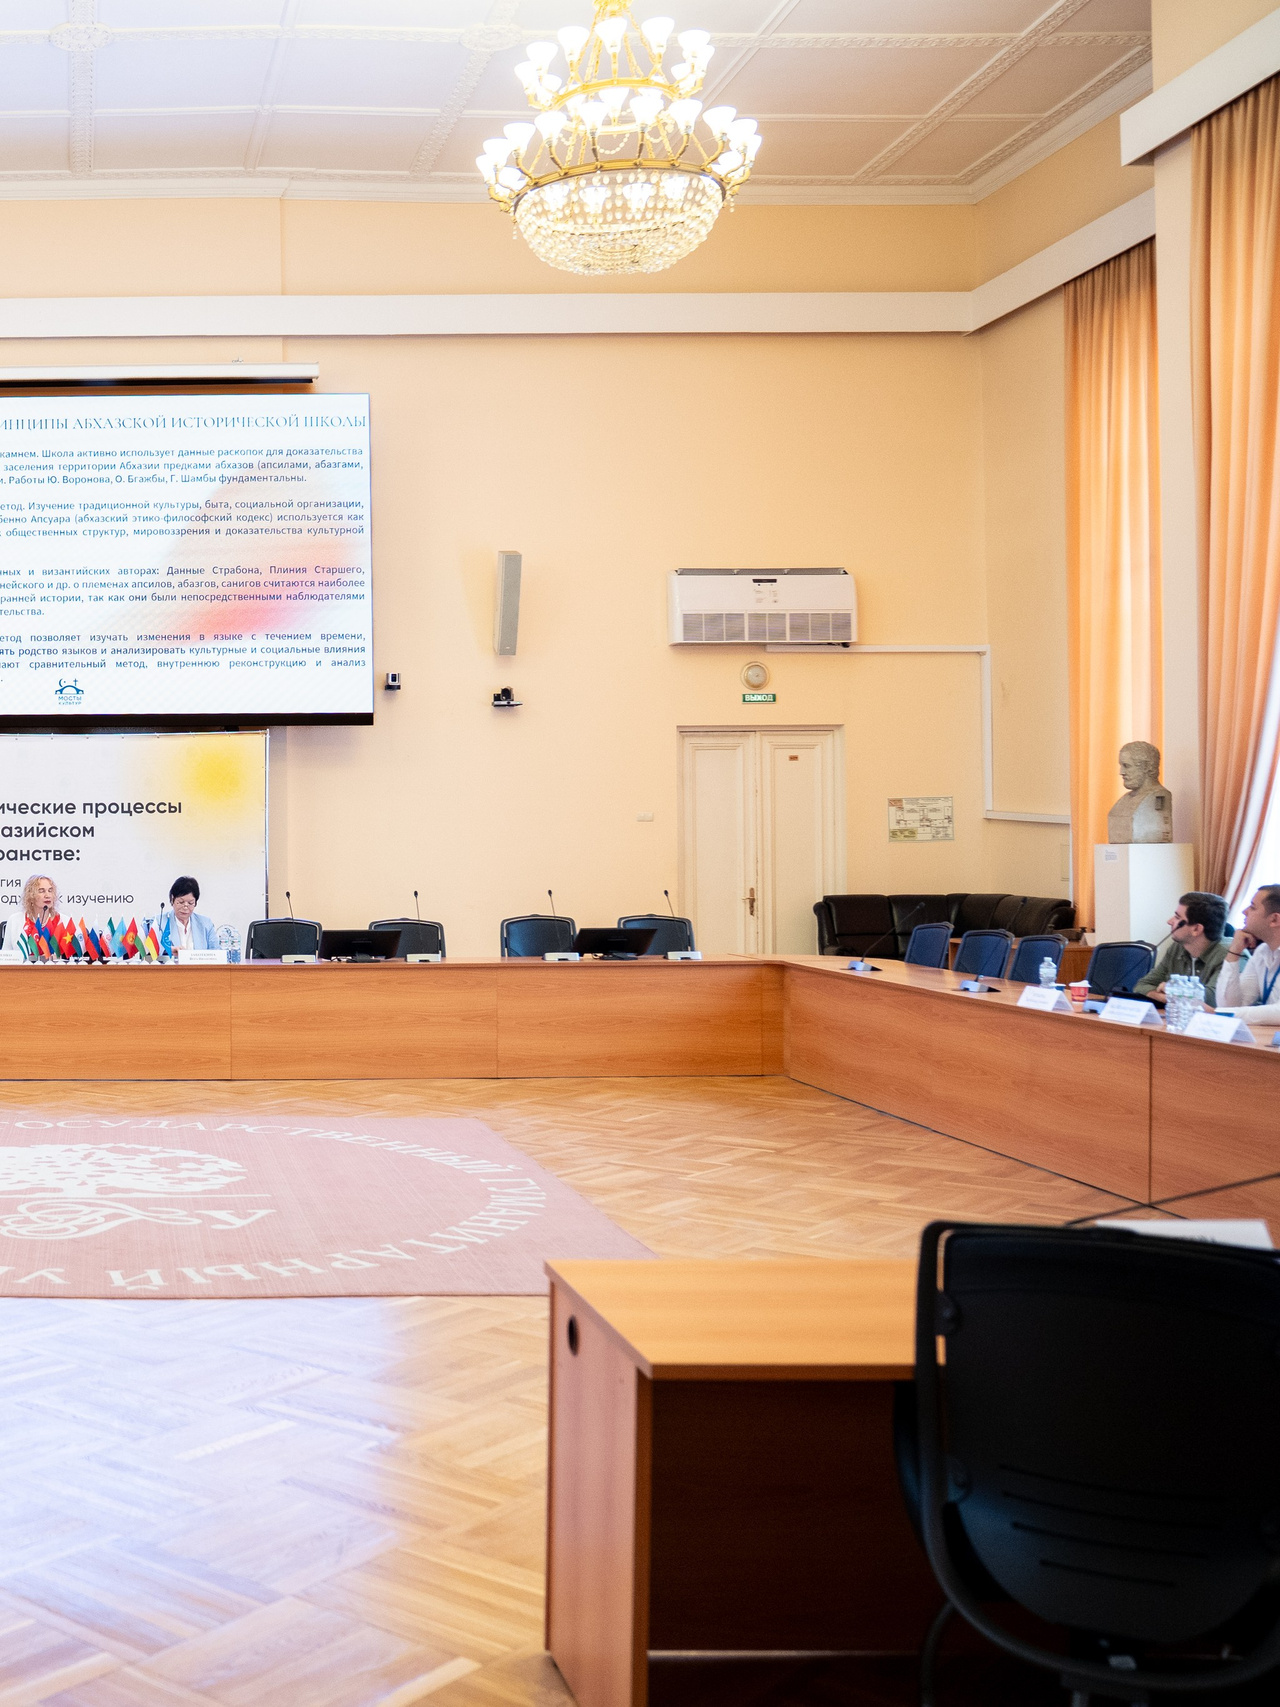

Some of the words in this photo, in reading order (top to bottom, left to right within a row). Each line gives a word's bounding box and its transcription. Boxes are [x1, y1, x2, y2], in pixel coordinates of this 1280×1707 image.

[72, 414, 166, 429] АБХАЗСКОЙ
[171, 413, 298, 428] ИСТОРИЧЕСКОЙ
[304, 415, 365, 427] ШКОЛЫ
[41, 449, 74, 458] Школа
[120, 449, 174, 458] использует
[177, 449, 215, 458] данные
[217, 449, 263, 457] раскопок
[285, 448, 363, 456] доказательства
[58, 463, 116, 472] территории
[119, 460, 159, 470] Абхазии
[163, 462, 211, 471] предками
[214, 460, 254, 469] абхазов
[257, 460, 311, 470] (апсилами,
[314, 459, 363, 469] абазгами,
[8, 475, 44, 484] Работы
[62, 475, 113, 485] Воронова,
[127, 473, 168, 484] Бгажбы,
[180, 473, 216, 483] Шамбы
[218, 474, 306, 484] фундаментальны.
[28, 501, 75, 511] Изучение
[78, 501, 150, 511] традиционной
[153, 502, 202, 511] культуры,
[234, 499, 293, 509] социальной
[296, 500, 364, 510] организации,
[30, 515, 70, 525] Апсуара
[74, 513, 128, 523] (абхазский
[236, 513, 272, 523] кодекс)
[276, 514, 343, 522] используется
[5, 527, 78, 537] общественных
[82, 528, 128, 538] структур,
[132, 528, 210, 537] мировоззрения
[225, 527, 302, 536] доказательства
[307, 525, 364, 536] культурной
[42, 566, 110, 576] византийских
[117, 567, 159, 577] авторах:
[166, 566, 205, 576] Данные
[212, 565, 262, 576] Страбона,
[269, 565, 307, 574] Плиния
[314, 565, 364, 575] Старшего,
[82, 581, 129, 589] племенах
[131, 581, 175, 590] апсилов,
[177, 578, 219, 589] абазгов,
[220, 580, 261, 588] санигов
[263, 580, 315, 588] считаются
[317, 577, 365, 587] наиболее
[0, 593, 36, 604] ранней
[40, 595, 84, 604] истории,
[180, 593, 282, 603] непосредственными
[286, 591, 365, 601] наблюдателями
[30, 634, 81, 642] позволяет
[89, 634, 128, 644] изучать
[320, 633, 365, 642] времени,
[18, 648, 58, 657] родство
[61, 647, 97, 655] языков
[110, 647, 185, 656] анализировать
[189, 646, 247, 656] культурные
[260, 646, 320, 654] социальные
[324, 646, 365, 654] влияния
[28, 659, 106, 670] сравнительный
[115, 660, 148, 669] метод,
[156, 660, 220, 669] внутреннюю
[228, 660, 306, 669] реконструкцию
[330, 659, 366, 667] анализ
[744, 694, 774, 702] ВЫХОД
[82, 802, 182, 818] процессы
[67, 894, 134, 906] изучению
[104, 1177, 547, 1291] ГУМАНИТАРНЫЙ
